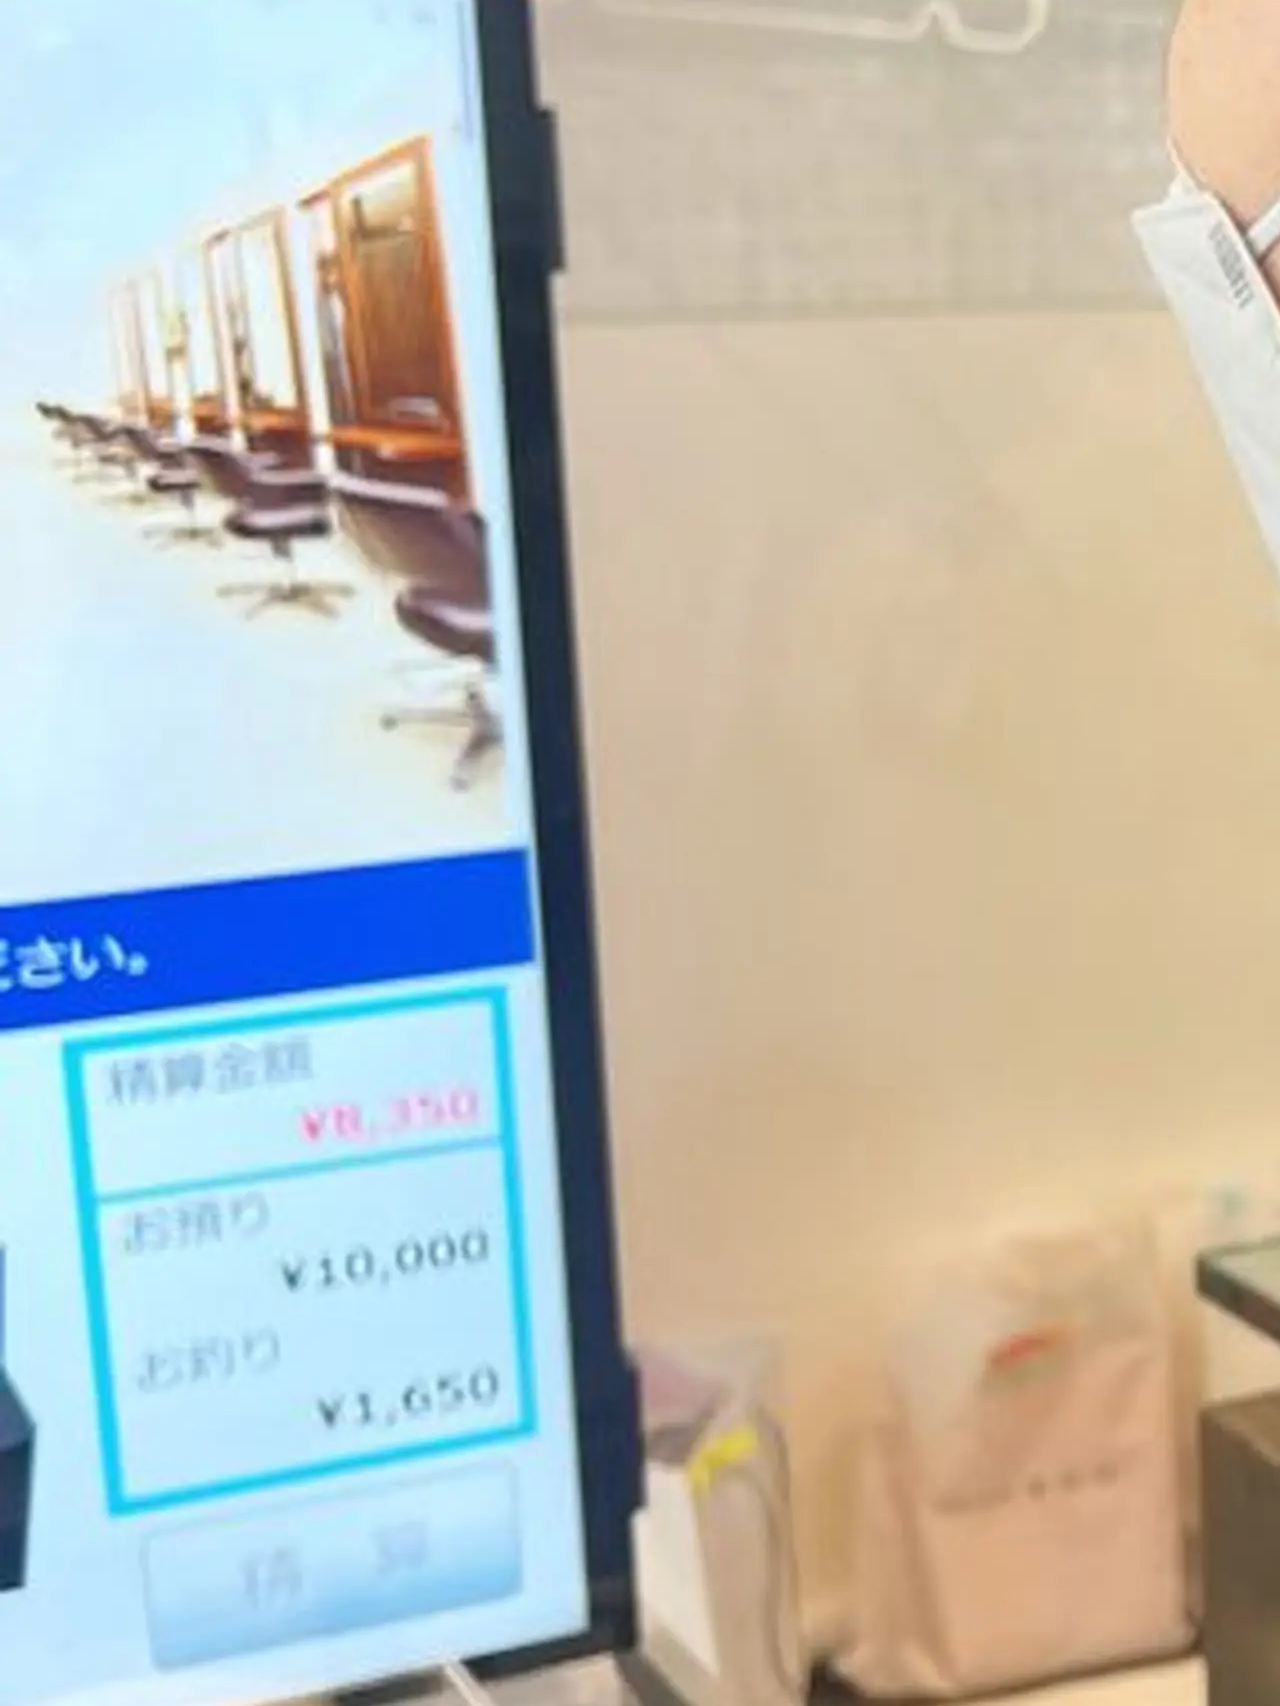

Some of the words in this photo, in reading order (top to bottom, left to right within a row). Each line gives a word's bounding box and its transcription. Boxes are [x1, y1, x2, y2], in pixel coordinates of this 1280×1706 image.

[0, 931, 149, 992] さい。
[280, 1227, 490, 1293] ¥10,000
[316, 1365, 501, 1430] ¥1,650
